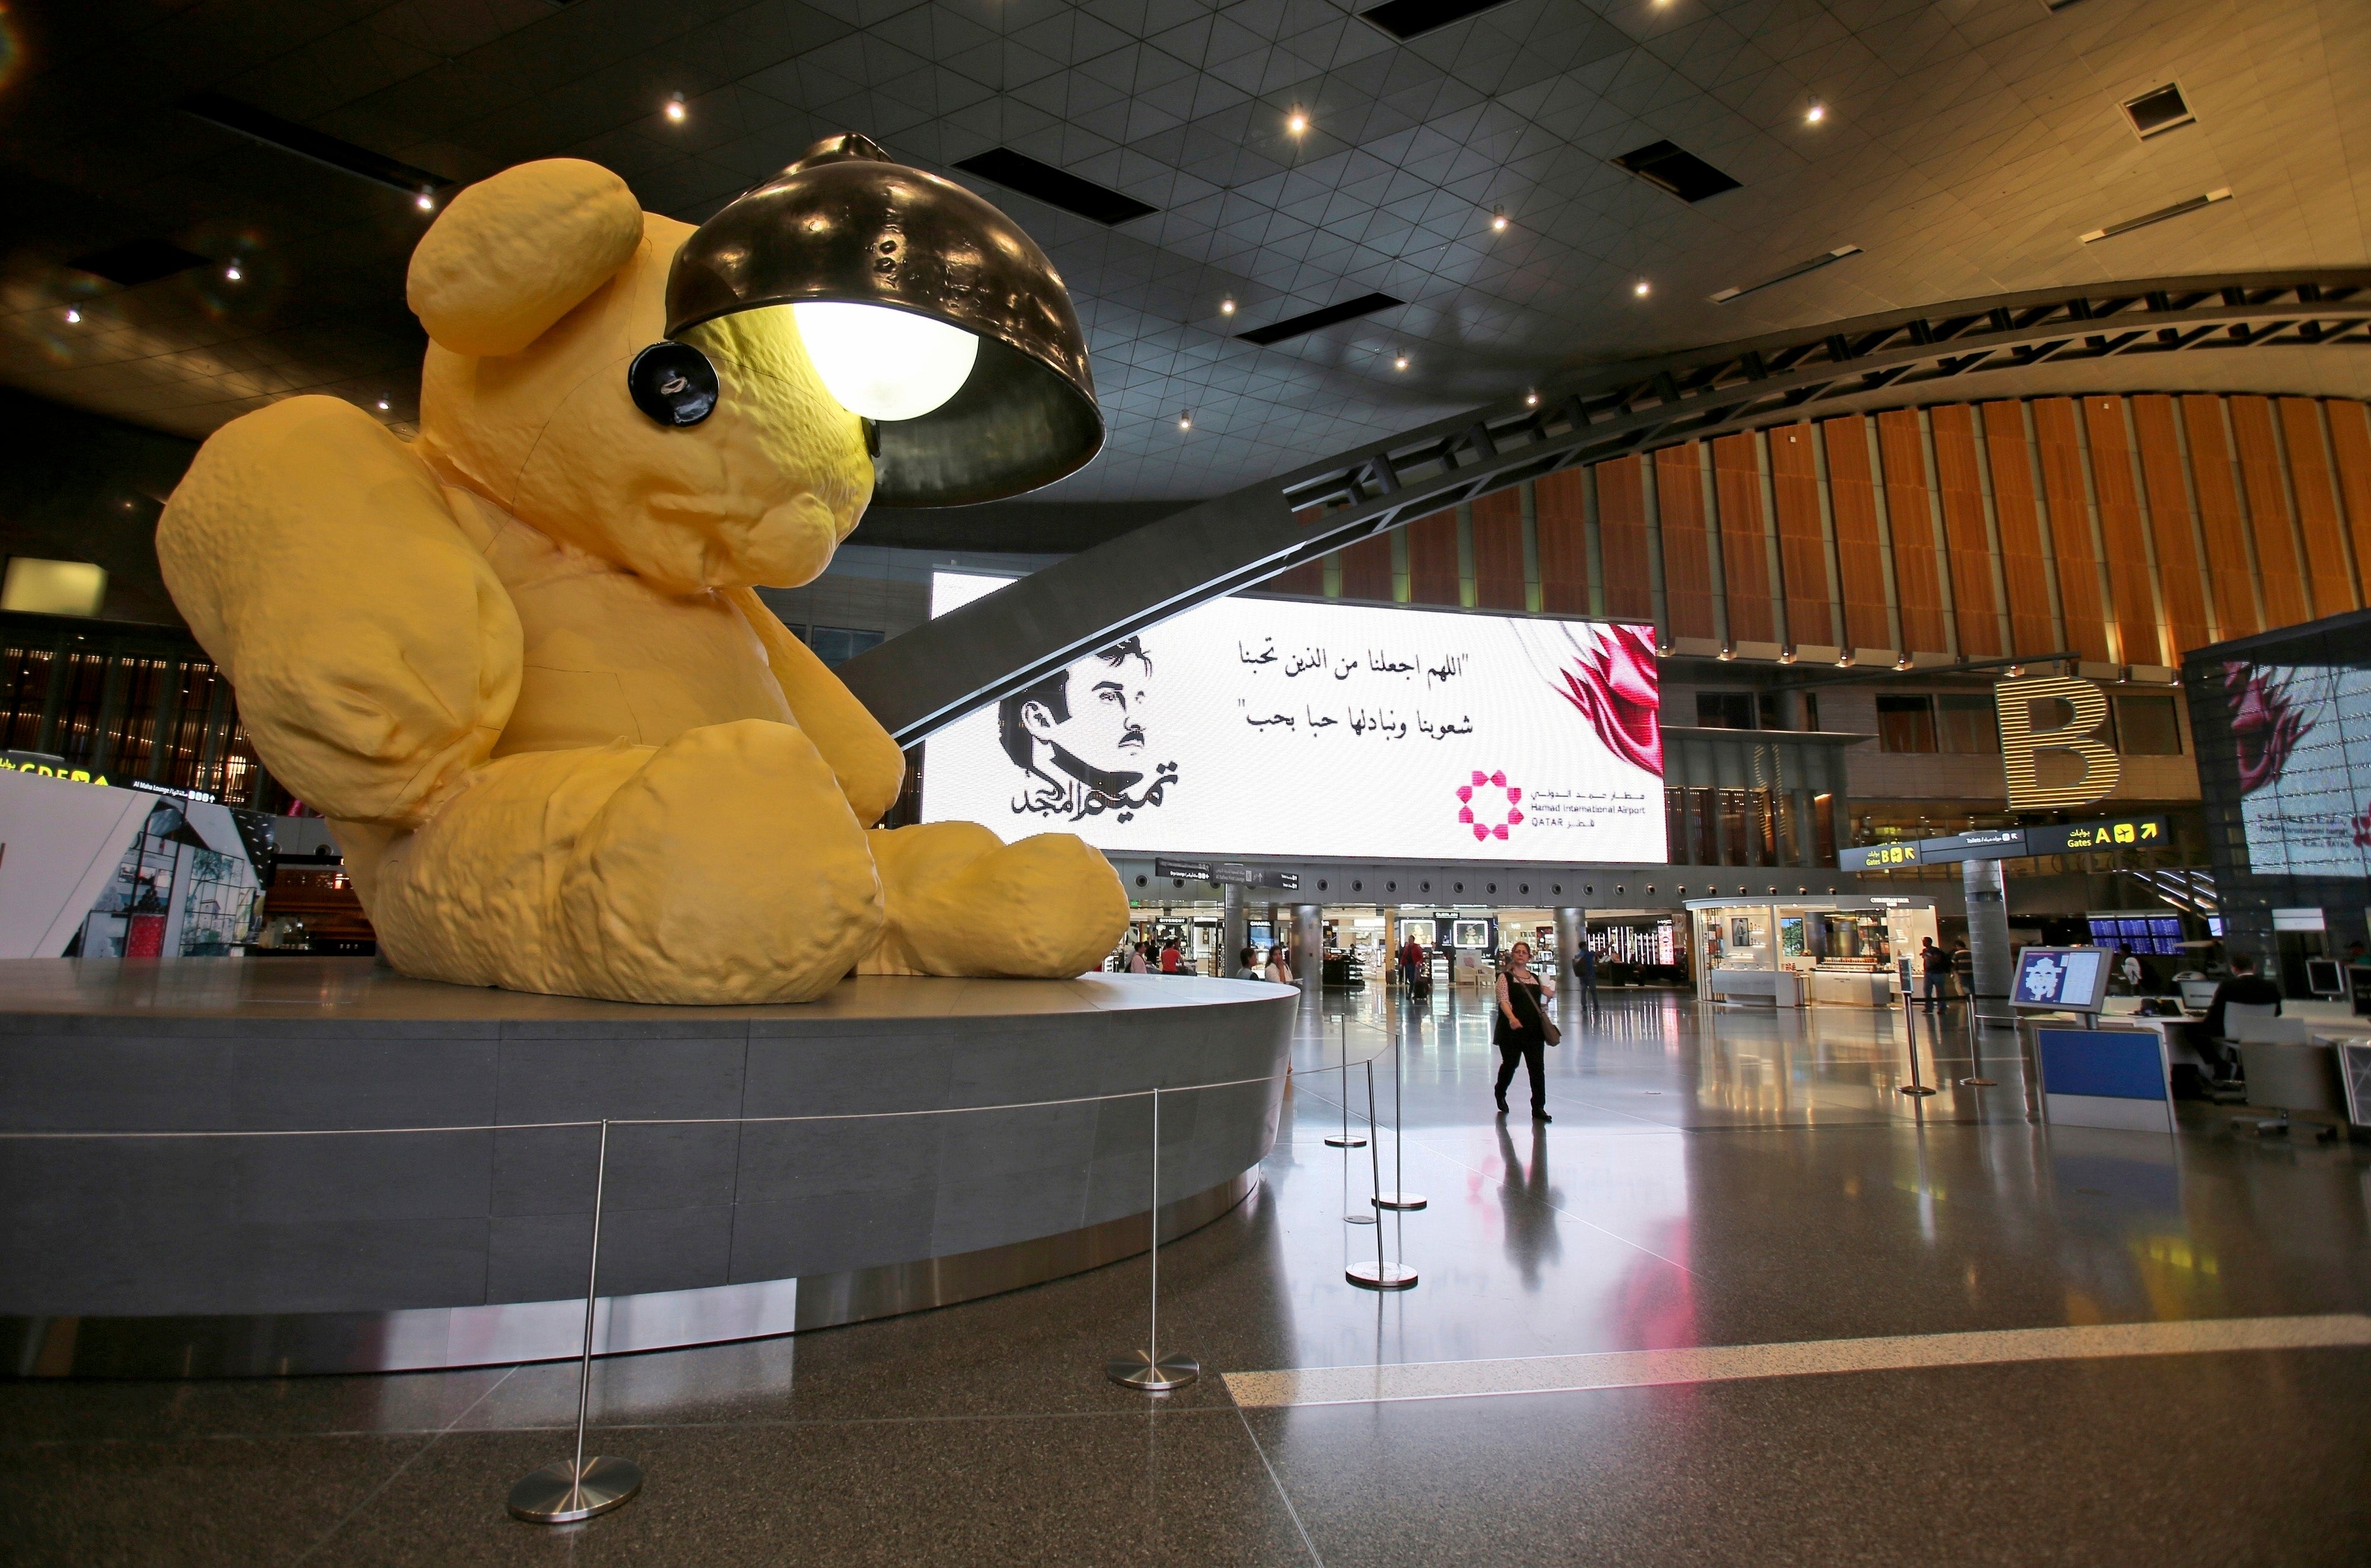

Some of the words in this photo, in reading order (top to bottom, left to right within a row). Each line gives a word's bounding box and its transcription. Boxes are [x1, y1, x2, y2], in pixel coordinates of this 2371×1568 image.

[1286, 648, 1327, 677] الذين
[1335, 658, 1357, 680] من
[1369, 649, 1420, 680] اجعلنا
[1308, 704, 1337, 737] حبا
[1349, 706, 1406, 740] ونبادلها
[1417, 711, 1472, 740] شعوبنا
[1994, 676, 2120, 810] B
[153, 785, 170, 794] Lounge
[1531, 803, 1560, 812] Hamad
[1564, 805, 1615, 814] International
[1618, 805, 1645, 815] Airport
[1532, 818, 1563, 827] QATAR
[2069, 828, 2091, 838] بوابات
[2095, 828, 2111, 844] A
[2067, 839, 2092, 847] Gates
[1881, 850, 1889, 863] B
